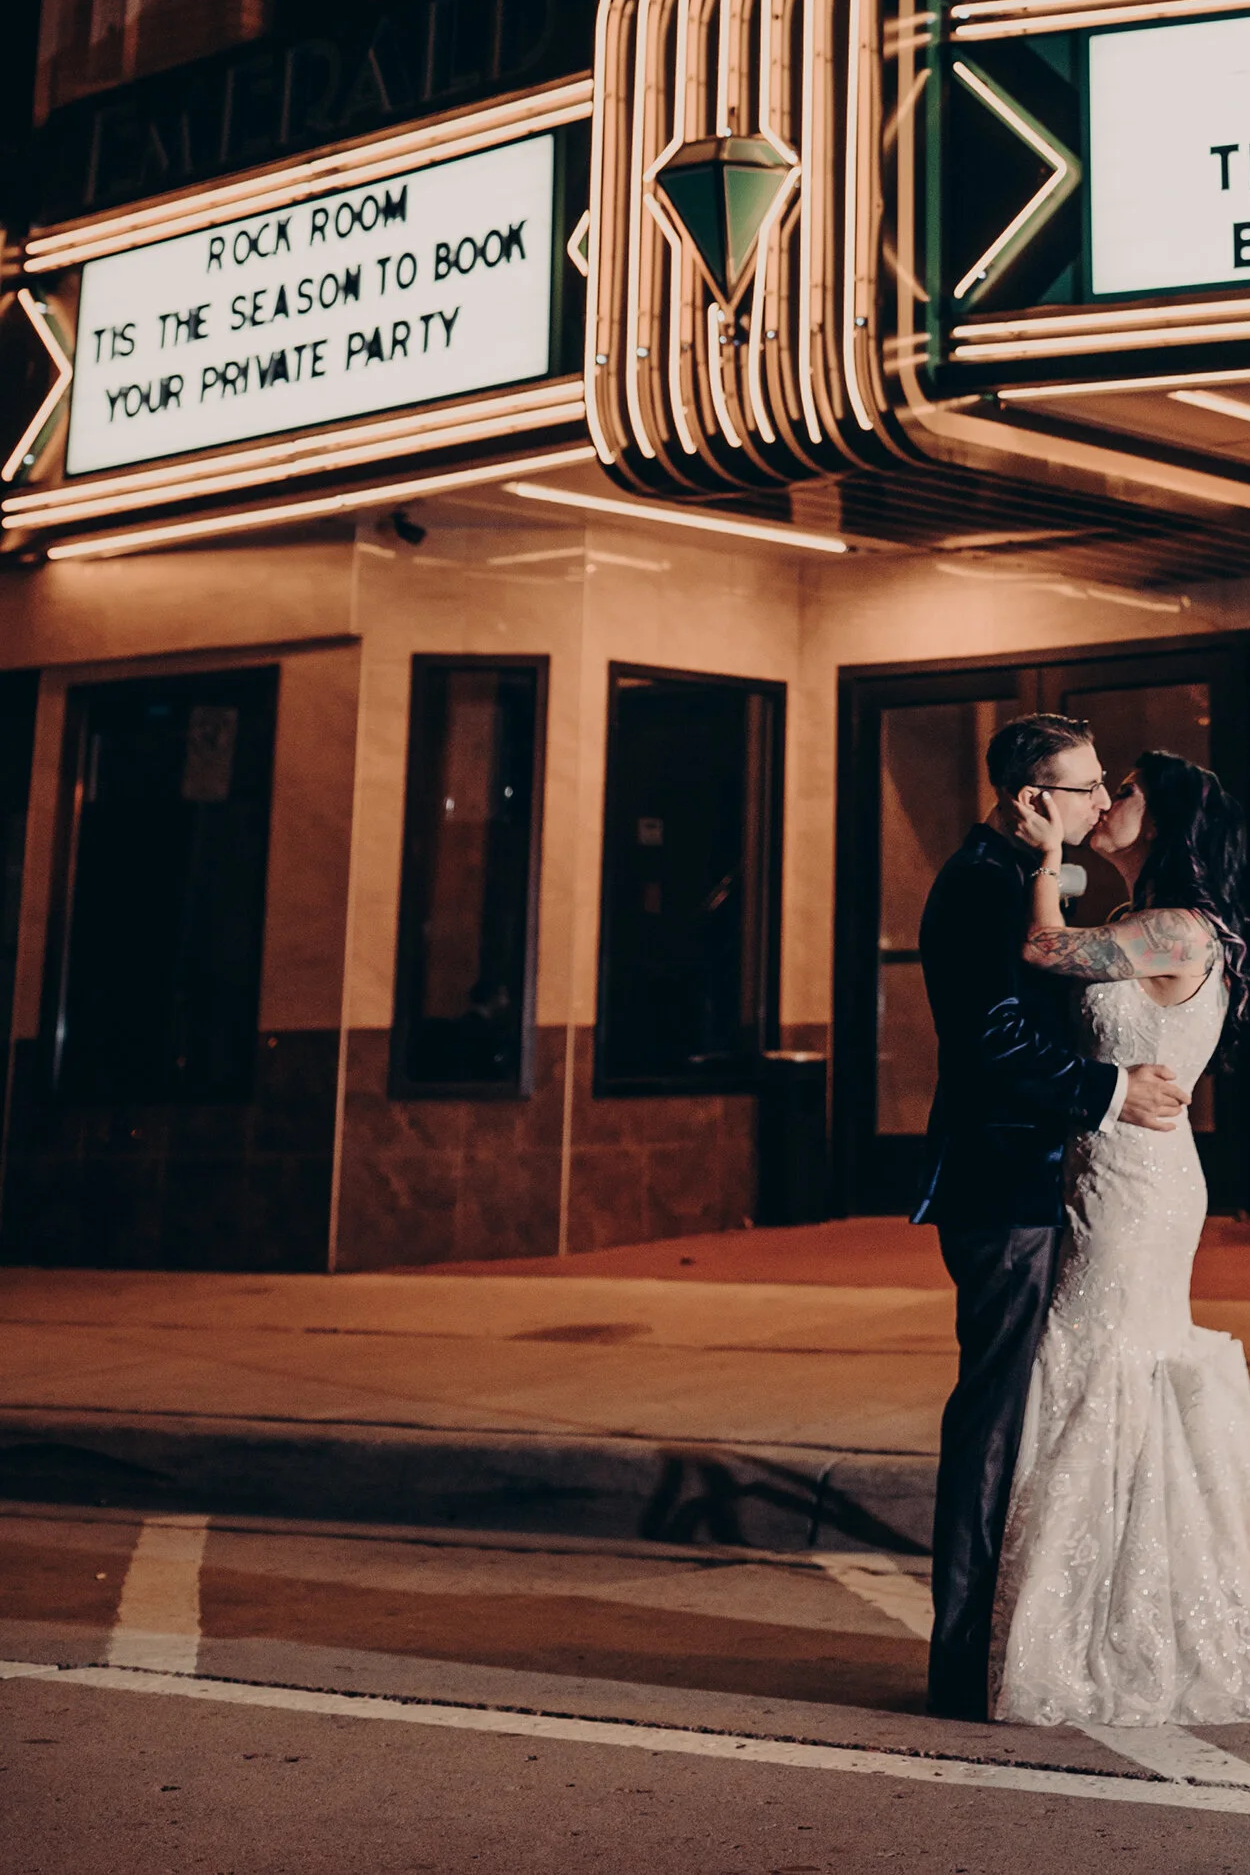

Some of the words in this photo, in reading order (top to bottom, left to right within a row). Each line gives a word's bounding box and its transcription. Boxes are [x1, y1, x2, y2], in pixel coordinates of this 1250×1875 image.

[206, 217, 292, 272] ROCK
[309, 184, 409, 246] ROOM
[93, 322, 136, 364] TIS
[158, 303, 211, 350] THE
[230, 263, 363, 332] SEASON
[376, 252, 418, 297] TO
[433, 219, 528, 283] BOOK
[104, 372, 185, 423] YOUR
[200, 343, 328, 404] PRIVATE
[345, 306, 462, 372] PARTY
